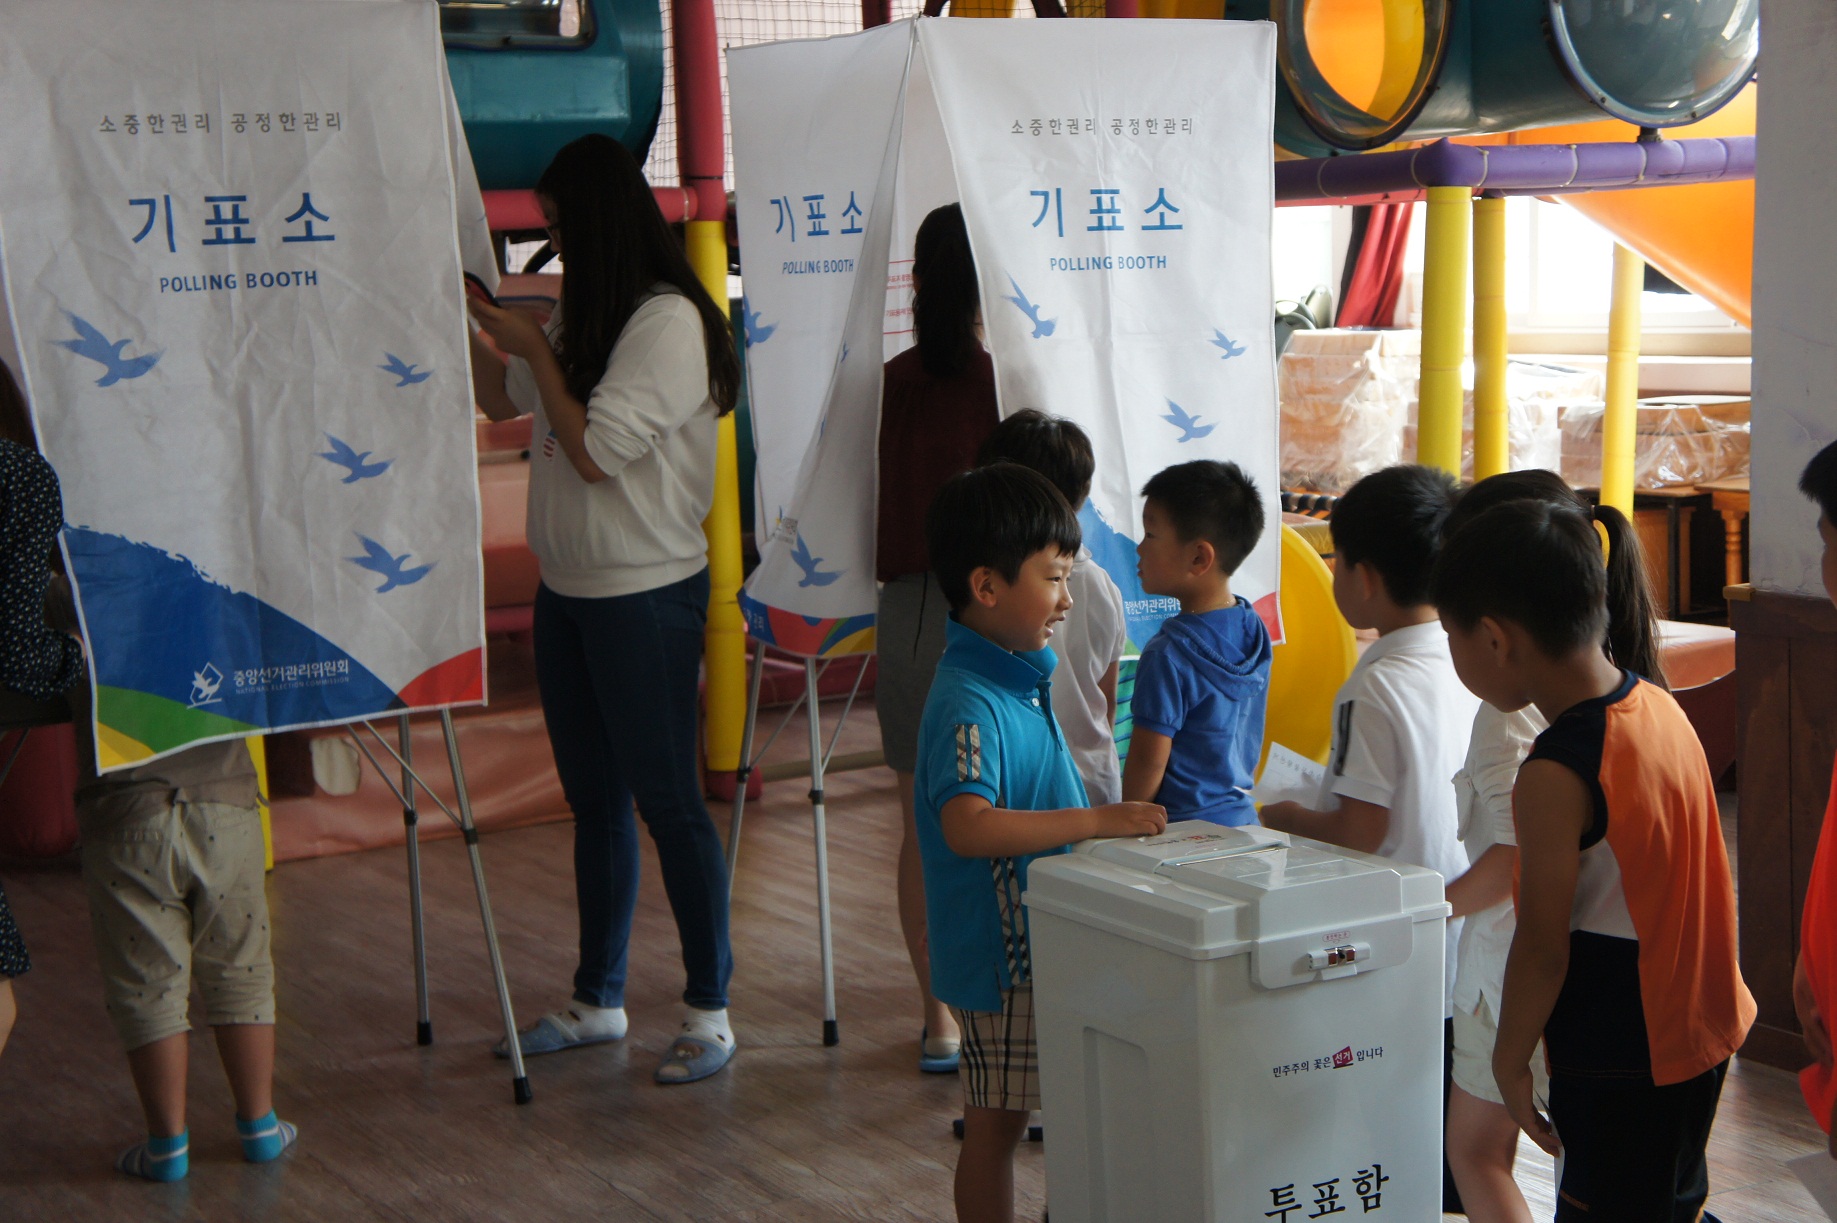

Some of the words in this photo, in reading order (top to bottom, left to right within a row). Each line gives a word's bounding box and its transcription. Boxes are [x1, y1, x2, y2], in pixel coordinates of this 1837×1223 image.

[99, 112, 211, 136] 소중한권리
[230, 112, 342, 134] 공정한관리
[1011, 118, 1097, 137] 소중한권리
[1110, 118, 1193, 136] 공정한관리
[128, 191, 336, 253] 기표소
[769, 190, 863, 243] 기표소
[1029, 187, 1184, 238] 기표소
[782, 260, 821, 275] POLLING
[823, 259, 854, 273] BOOTH
[1050, 256, 1114, 271] POLLING
[1117, 255, 1168, 270] BOOTH
[159, 273, 238, 293] POLLING
[246, 270, 318, 289] BOOTH
[233, 658, 350, 688] 중앙선거관리위원회
[1273, 1060, 1309, 1078] 민주주의
[1313, 1056, 1332, 1070] 꽃은
[1334, 1050, 1352, 1065] 선거
[1356, 1046, 1384, 1062] 입니다
[1264, 1163, 1390, 1223] 투표함
